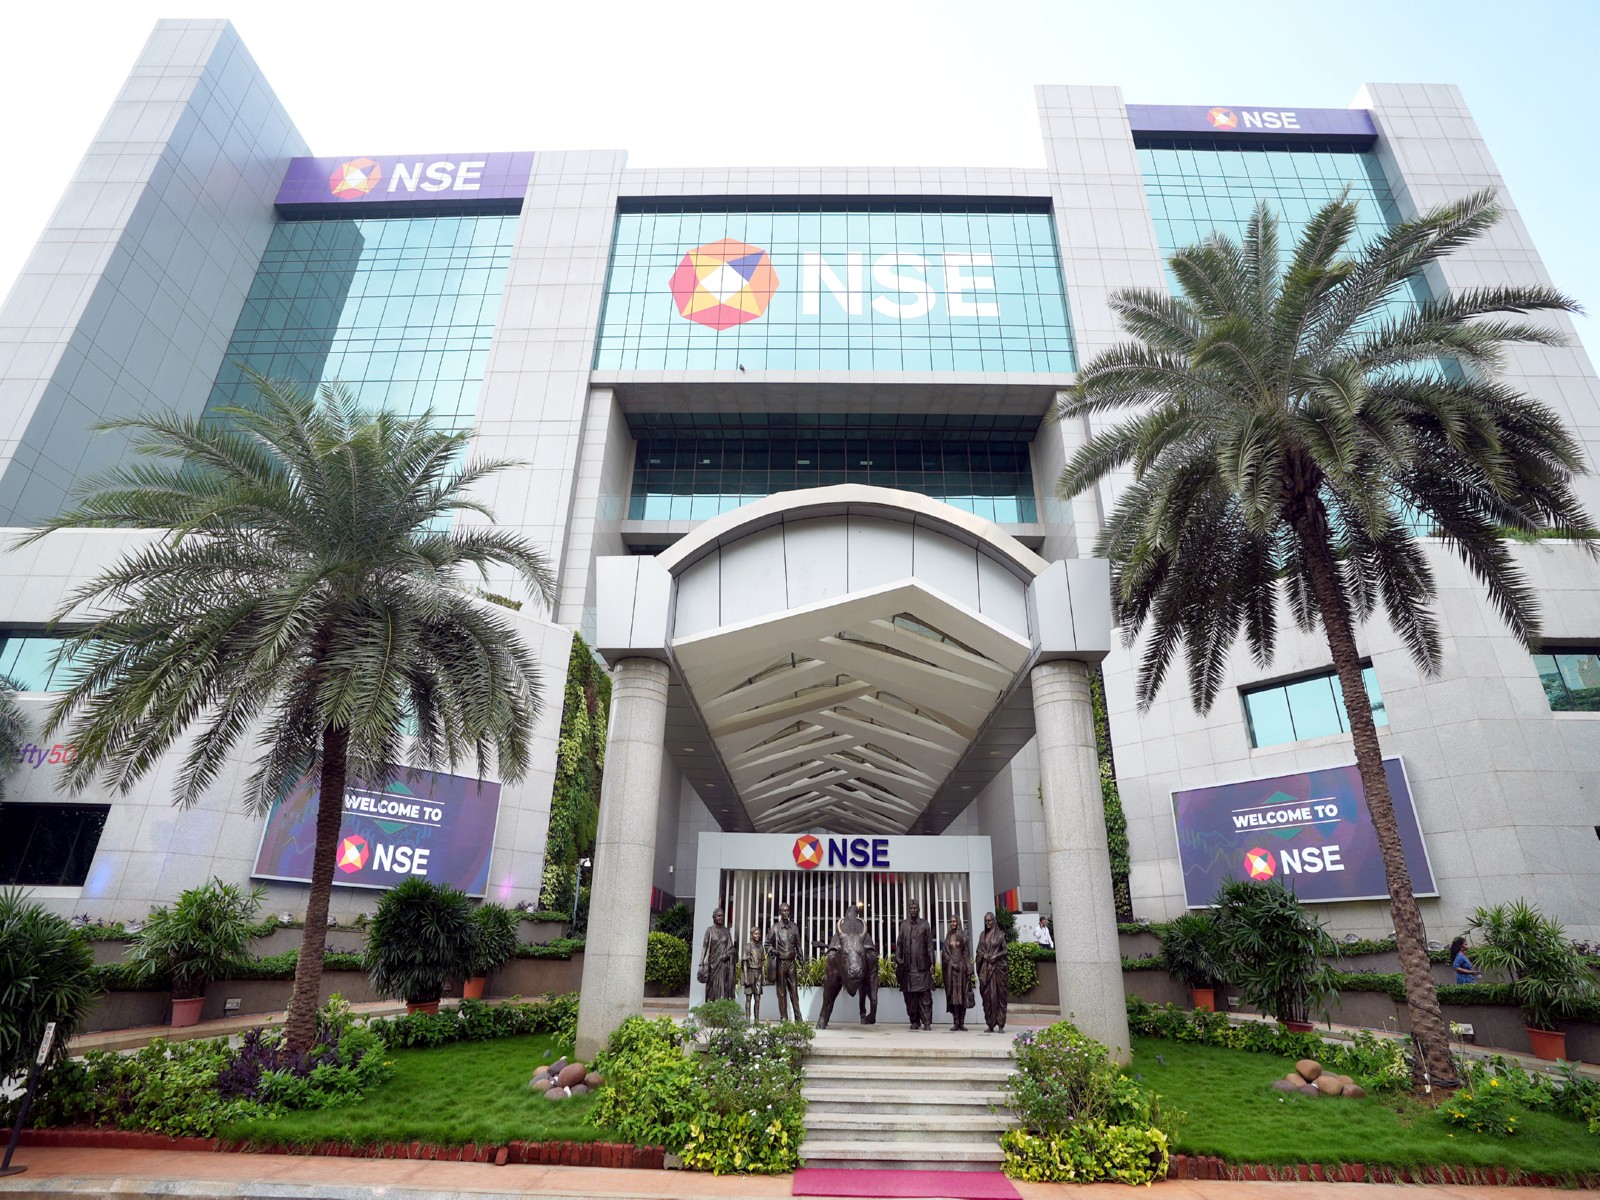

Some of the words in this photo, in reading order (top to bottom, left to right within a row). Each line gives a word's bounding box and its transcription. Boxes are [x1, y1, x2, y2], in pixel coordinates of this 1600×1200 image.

[1242, 111, 1301, 129] NSE
[387, 160, 486, 193] NSE
[802, 251, 1000, 319] NSE
[344, 794, 420, 819] WELCOME
[423, 806, 442, 822] TO
[1232, 807, 1313, 828] WELCOME
[1314, 804, 1338, 818] TO
[372, 843, 430, 876] NSE
[828, 838, 890, 868] NSE
[1280, 845, 1345, 875] NSE
